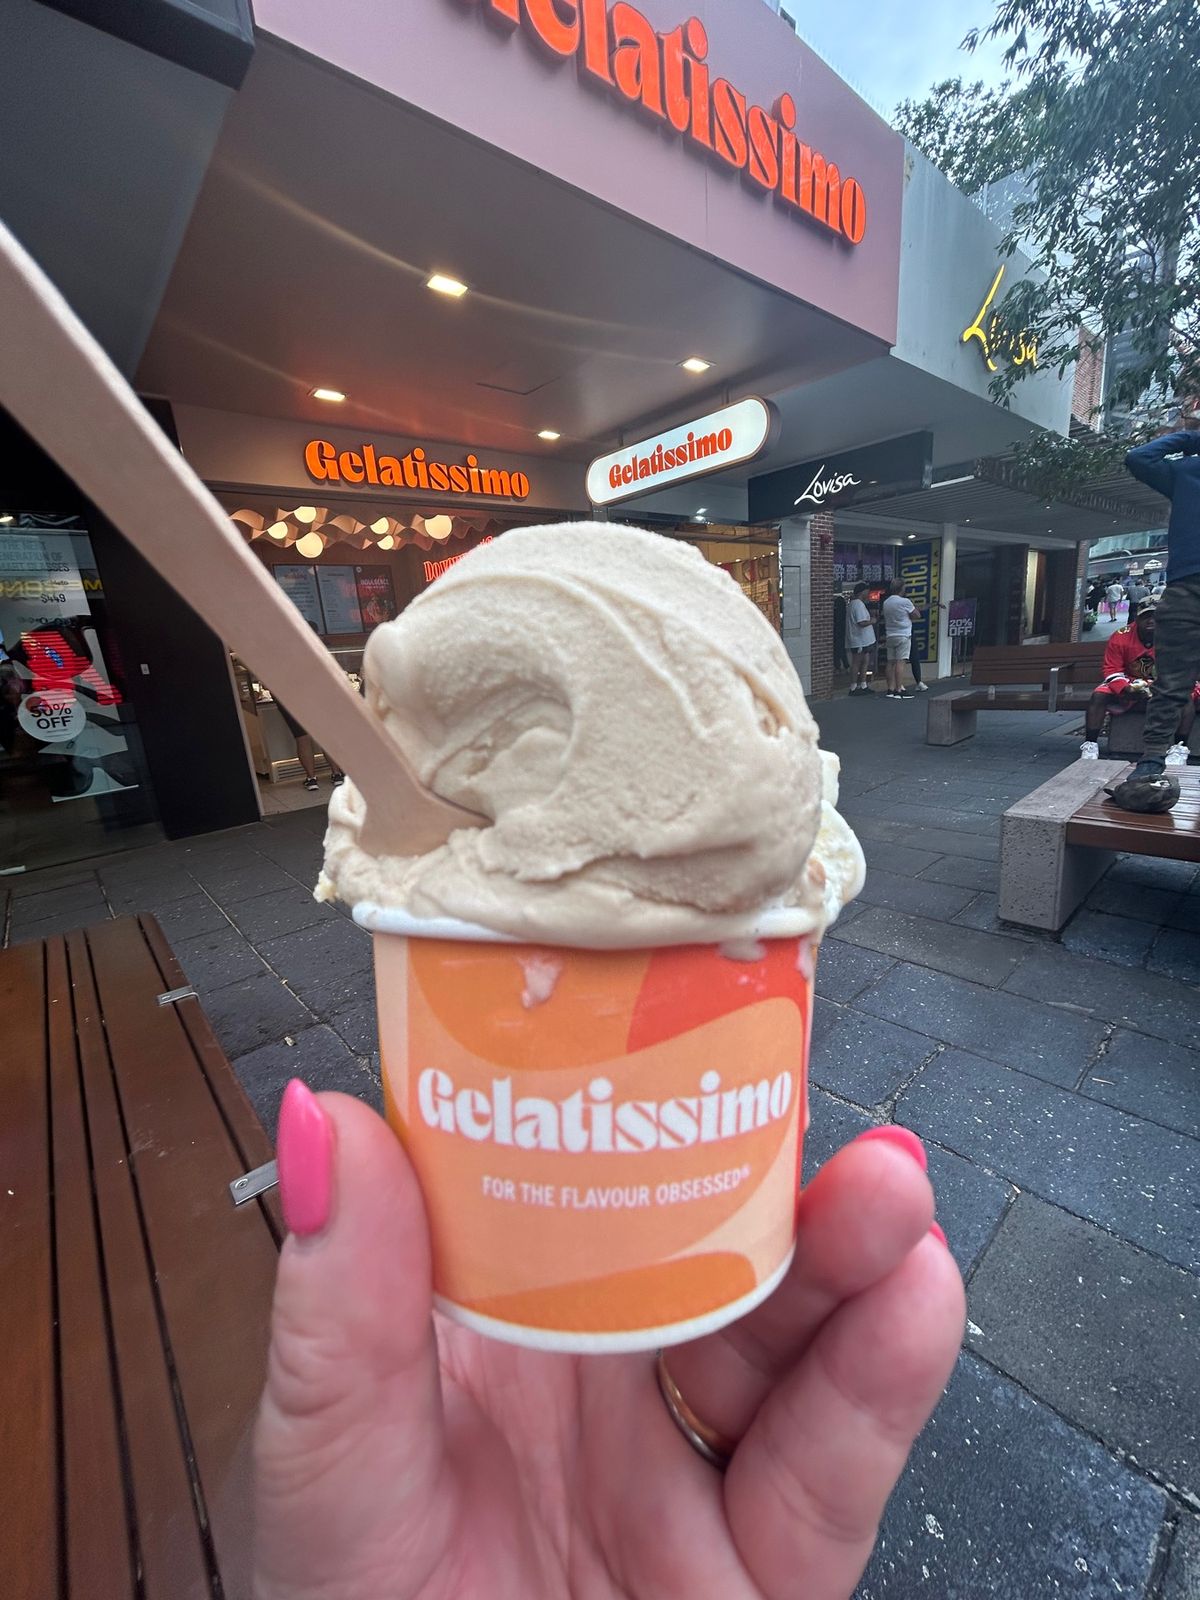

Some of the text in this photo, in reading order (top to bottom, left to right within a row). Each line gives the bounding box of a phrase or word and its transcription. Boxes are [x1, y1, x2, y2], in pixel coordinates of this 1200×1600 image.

[491, 0, 866, 245] elatissimo
[304, 439, 530, 498] Gelatissimo
[608, 427, 733, 489] Gelatissimo
[793, 464, 862, 505] Lovisa
[948, 626, 973, 637] OFF
[949, 618, 973, 628] 20%
[36, 715, 73, 730] OFF
[417, 1067, 792, 1153] Gelatissimo
[482, 1175, 516, 1200] FOR
[520, 1181, 554, 1206] THE
[560, 1183, 651, 1210] FLAVOUR
